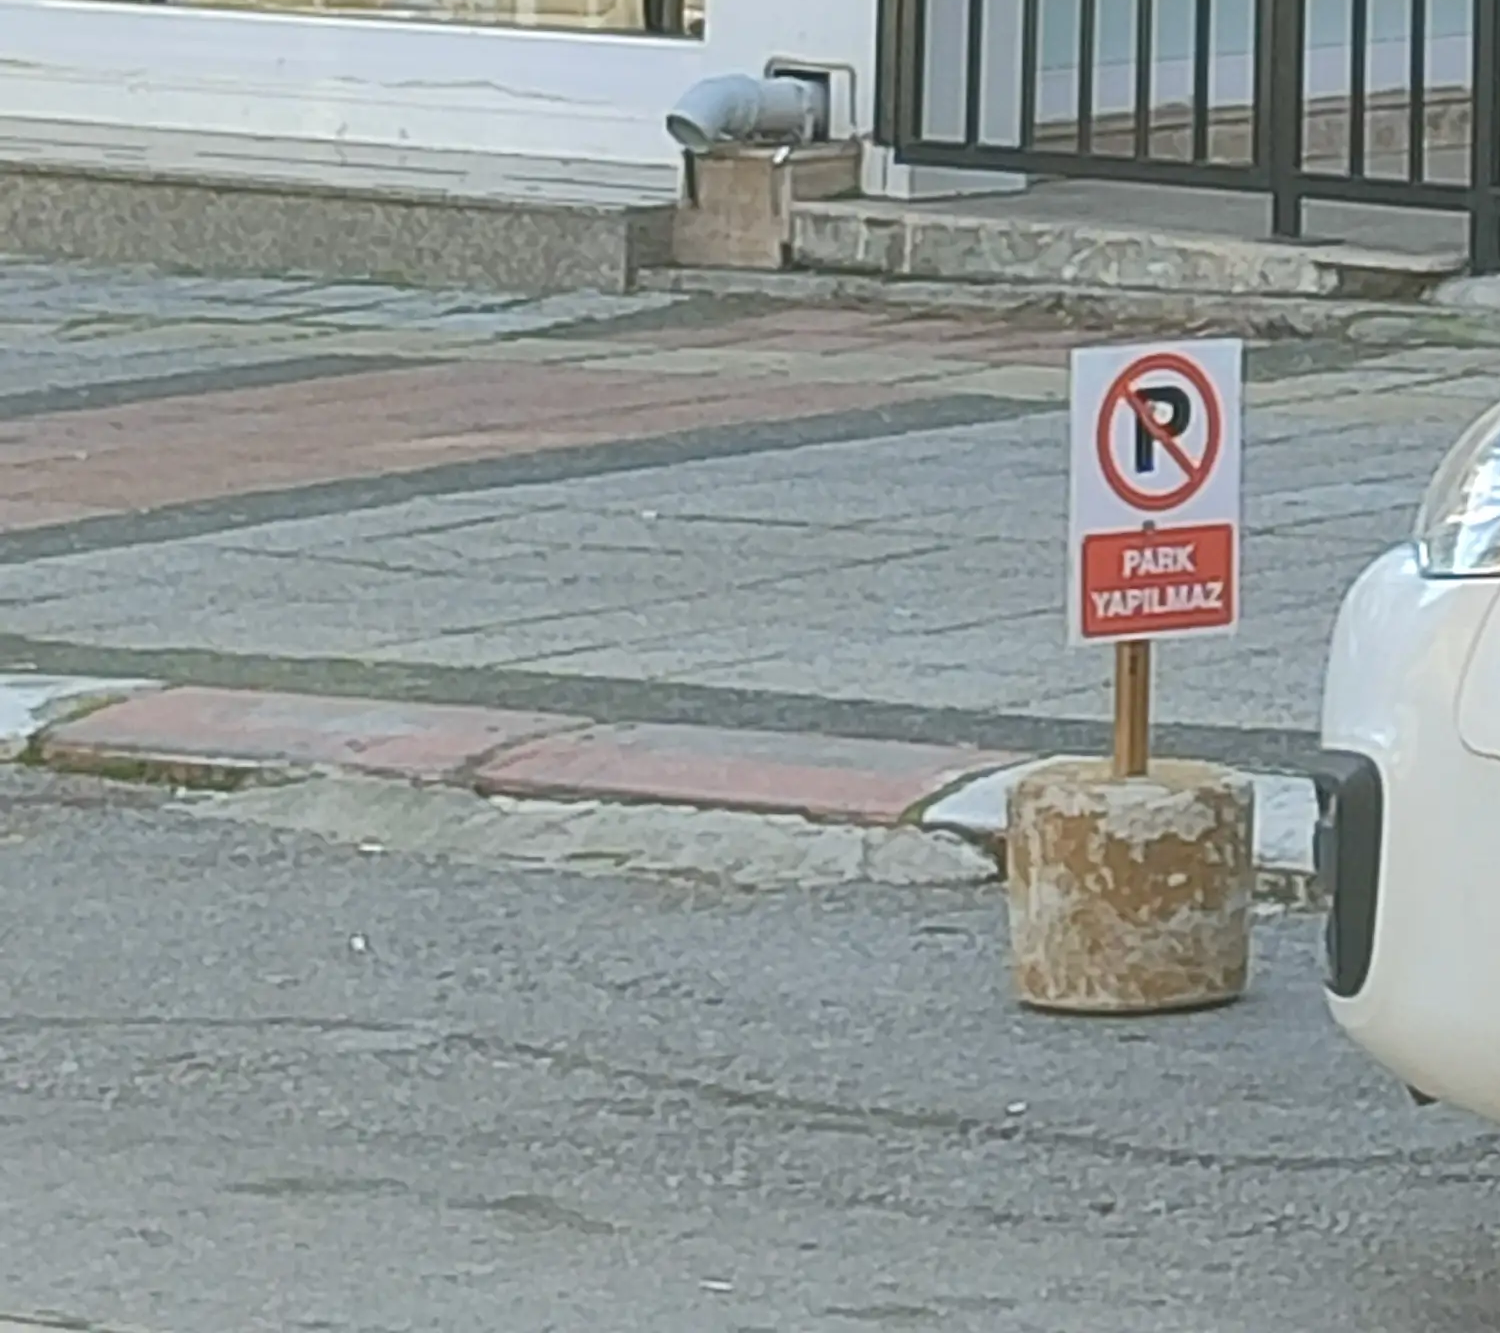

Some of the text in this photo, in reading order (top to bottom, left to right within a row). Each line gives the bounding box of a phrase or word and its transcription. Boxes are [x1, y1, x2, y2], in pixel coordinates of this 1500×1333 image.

[1135, 386, 1191, 473] P
[1121, 541, 1196, 579] PARK
[1090, 581, 1224, 619] YAPILMAZ
